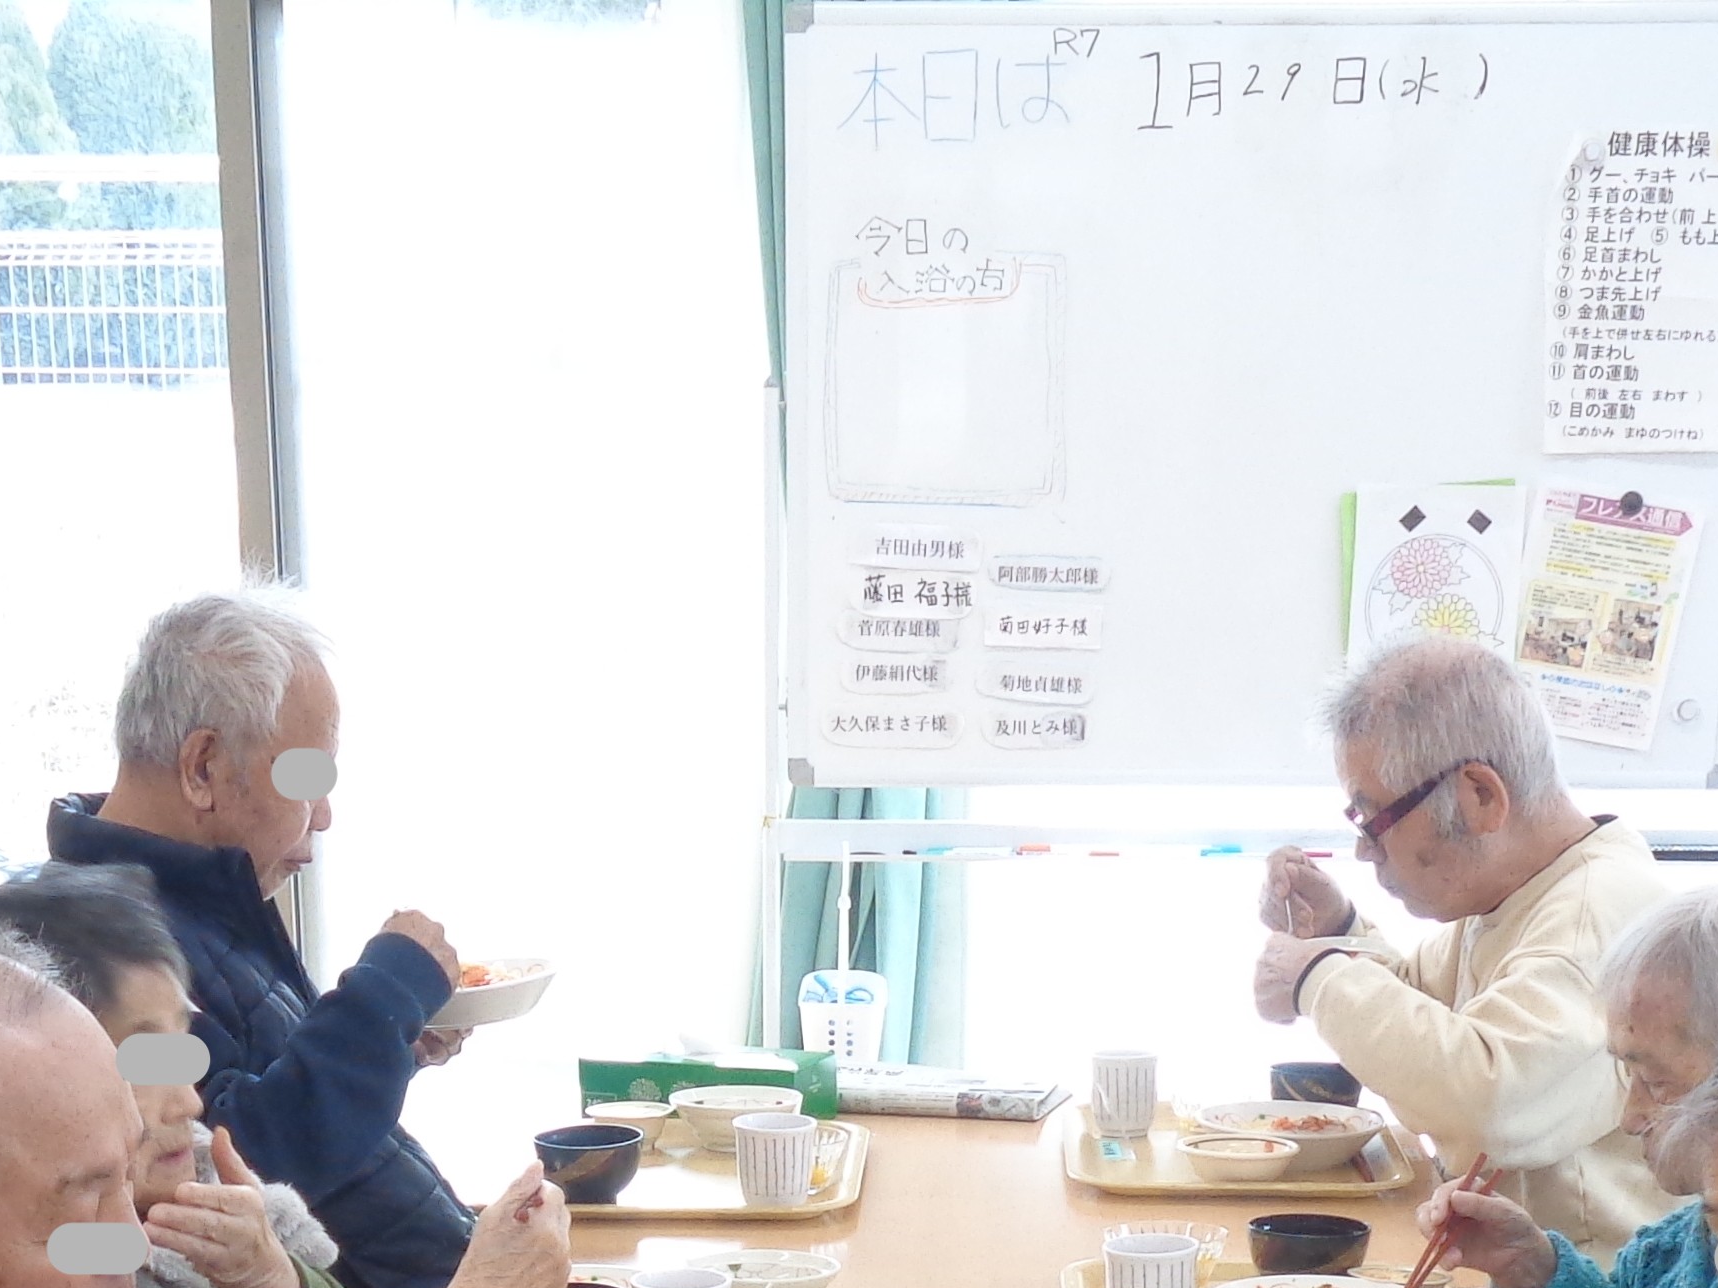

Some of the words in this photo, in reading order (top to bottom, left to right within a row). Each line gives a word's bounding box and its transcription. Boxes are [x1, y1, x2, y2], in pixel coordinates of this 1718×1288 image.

[837, 46, 1073, 151] 本日は
[1608, 131, 1711, 158] 健康体操
[1587, 187, 1674, 204] 手首の運動
[855, 216, 969, 255] 今日の
[1584, 226, 1635, 243] 足上げ
[1582, 247, 1662, 264] 足首まわし
[1581, 266, 1662, 283] かかと上げ
[1579, 286, 1662, 302] つま先上げ
[1577, 304, 1645, 321] 金魚運動
[1573, 343, 1635, 361] 肩まわし
[1572, 364, 1640, 382] 首の運動
[1569, 401, 1636, 420] 目の運動
[1582, 497, 1684, 530] フレス通信
[997, 565, 1100, 586] 阿部勝太郎様
[831, 714, 949, 733] 大久保まさ子様
[996, 718, 1079, 737] 及川とみ様
